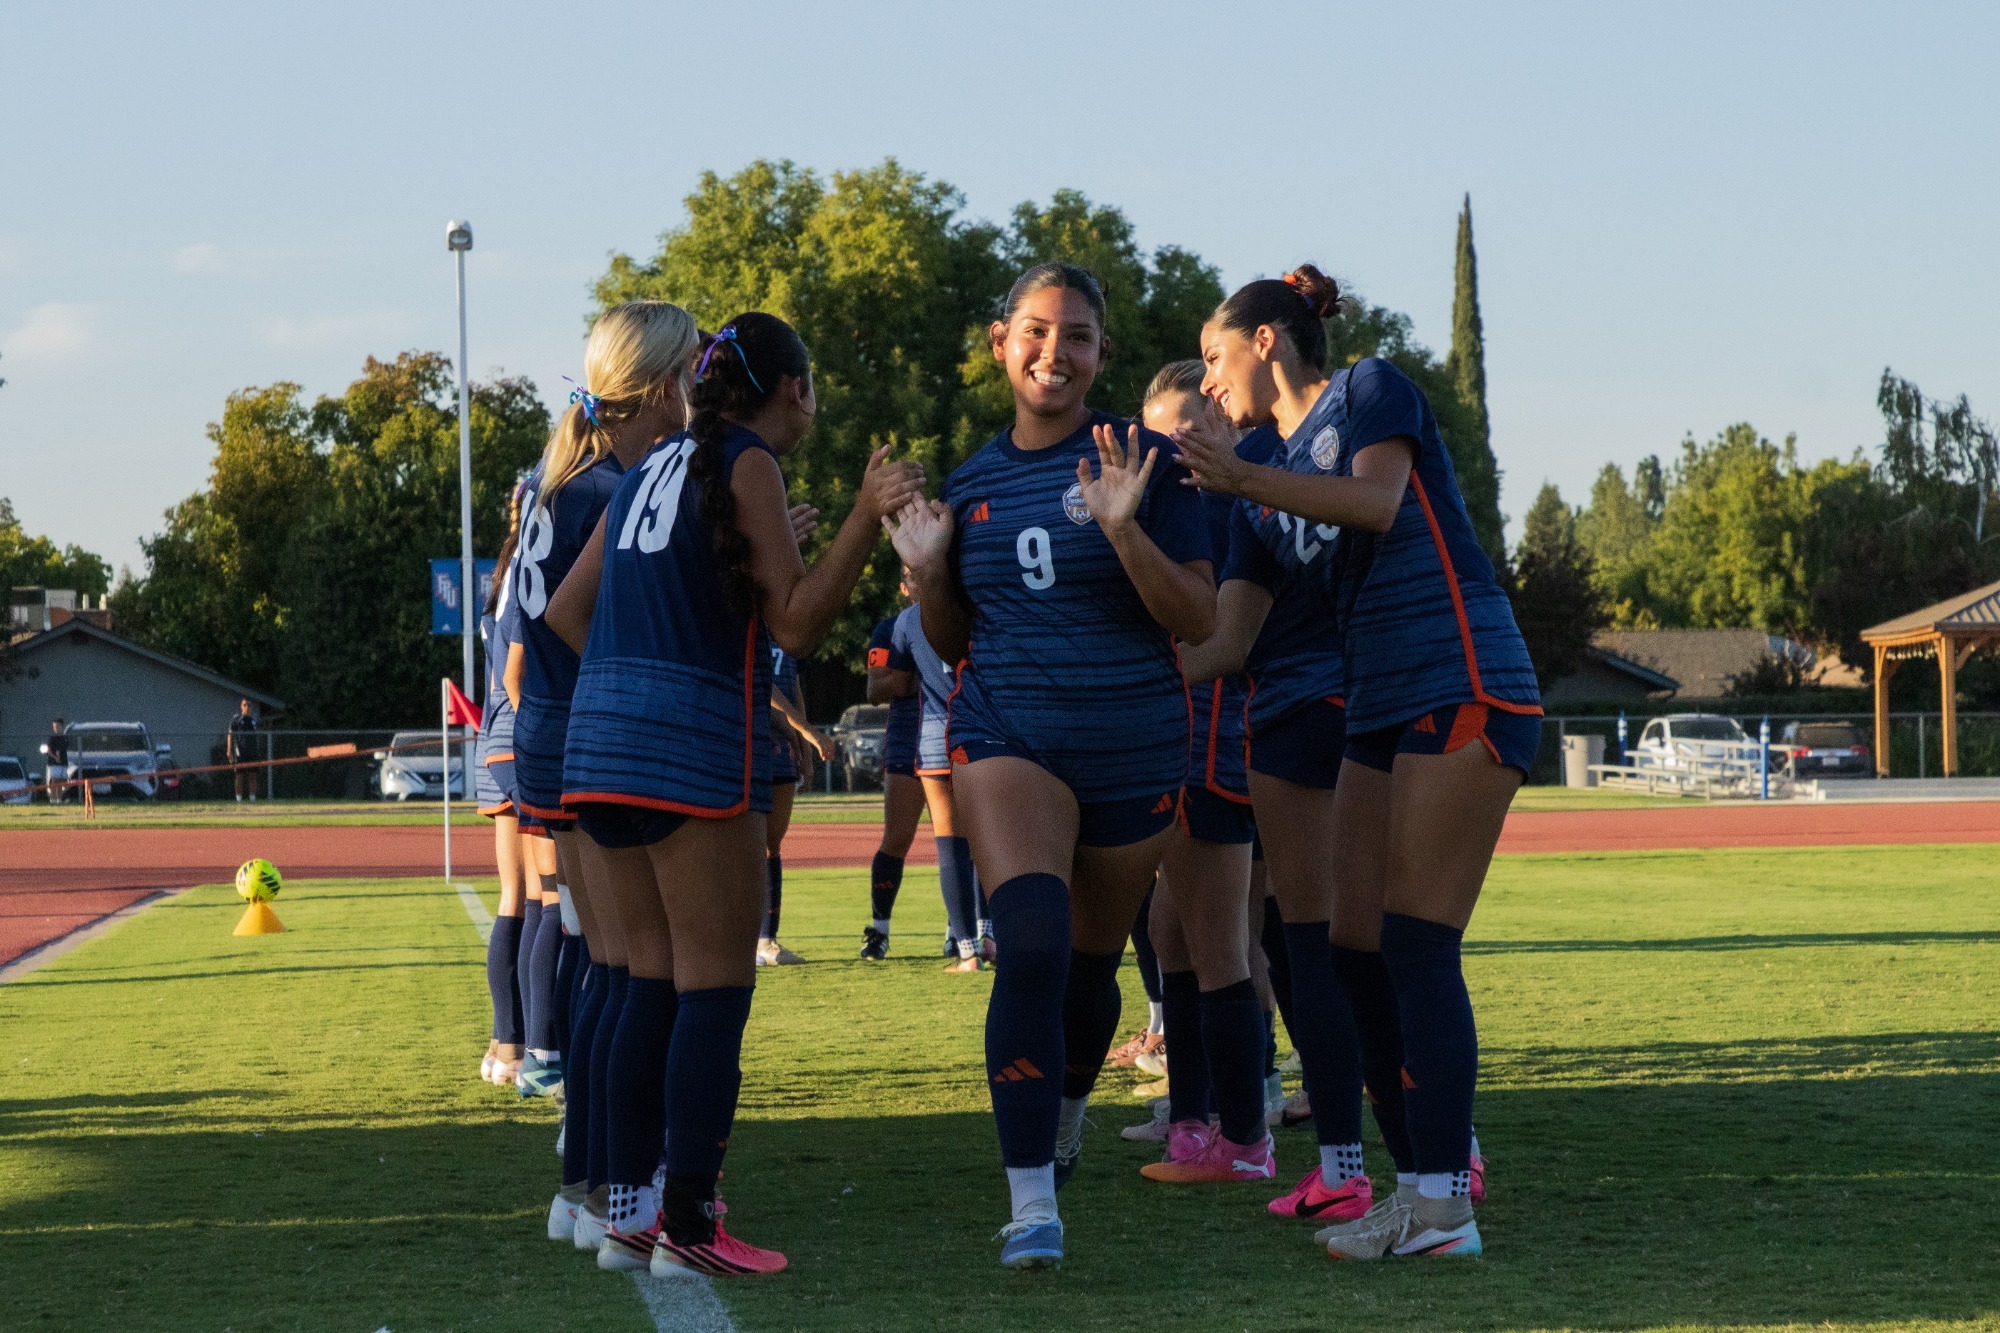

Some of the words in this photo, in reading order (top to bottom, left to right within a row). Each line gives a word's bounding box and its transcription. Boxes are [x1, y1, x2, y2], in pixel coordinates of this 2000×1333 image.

[617, 438, 698, 554] 19
[1016, 526, 1056, 590] 9
[869, 650, 877, 666] C
